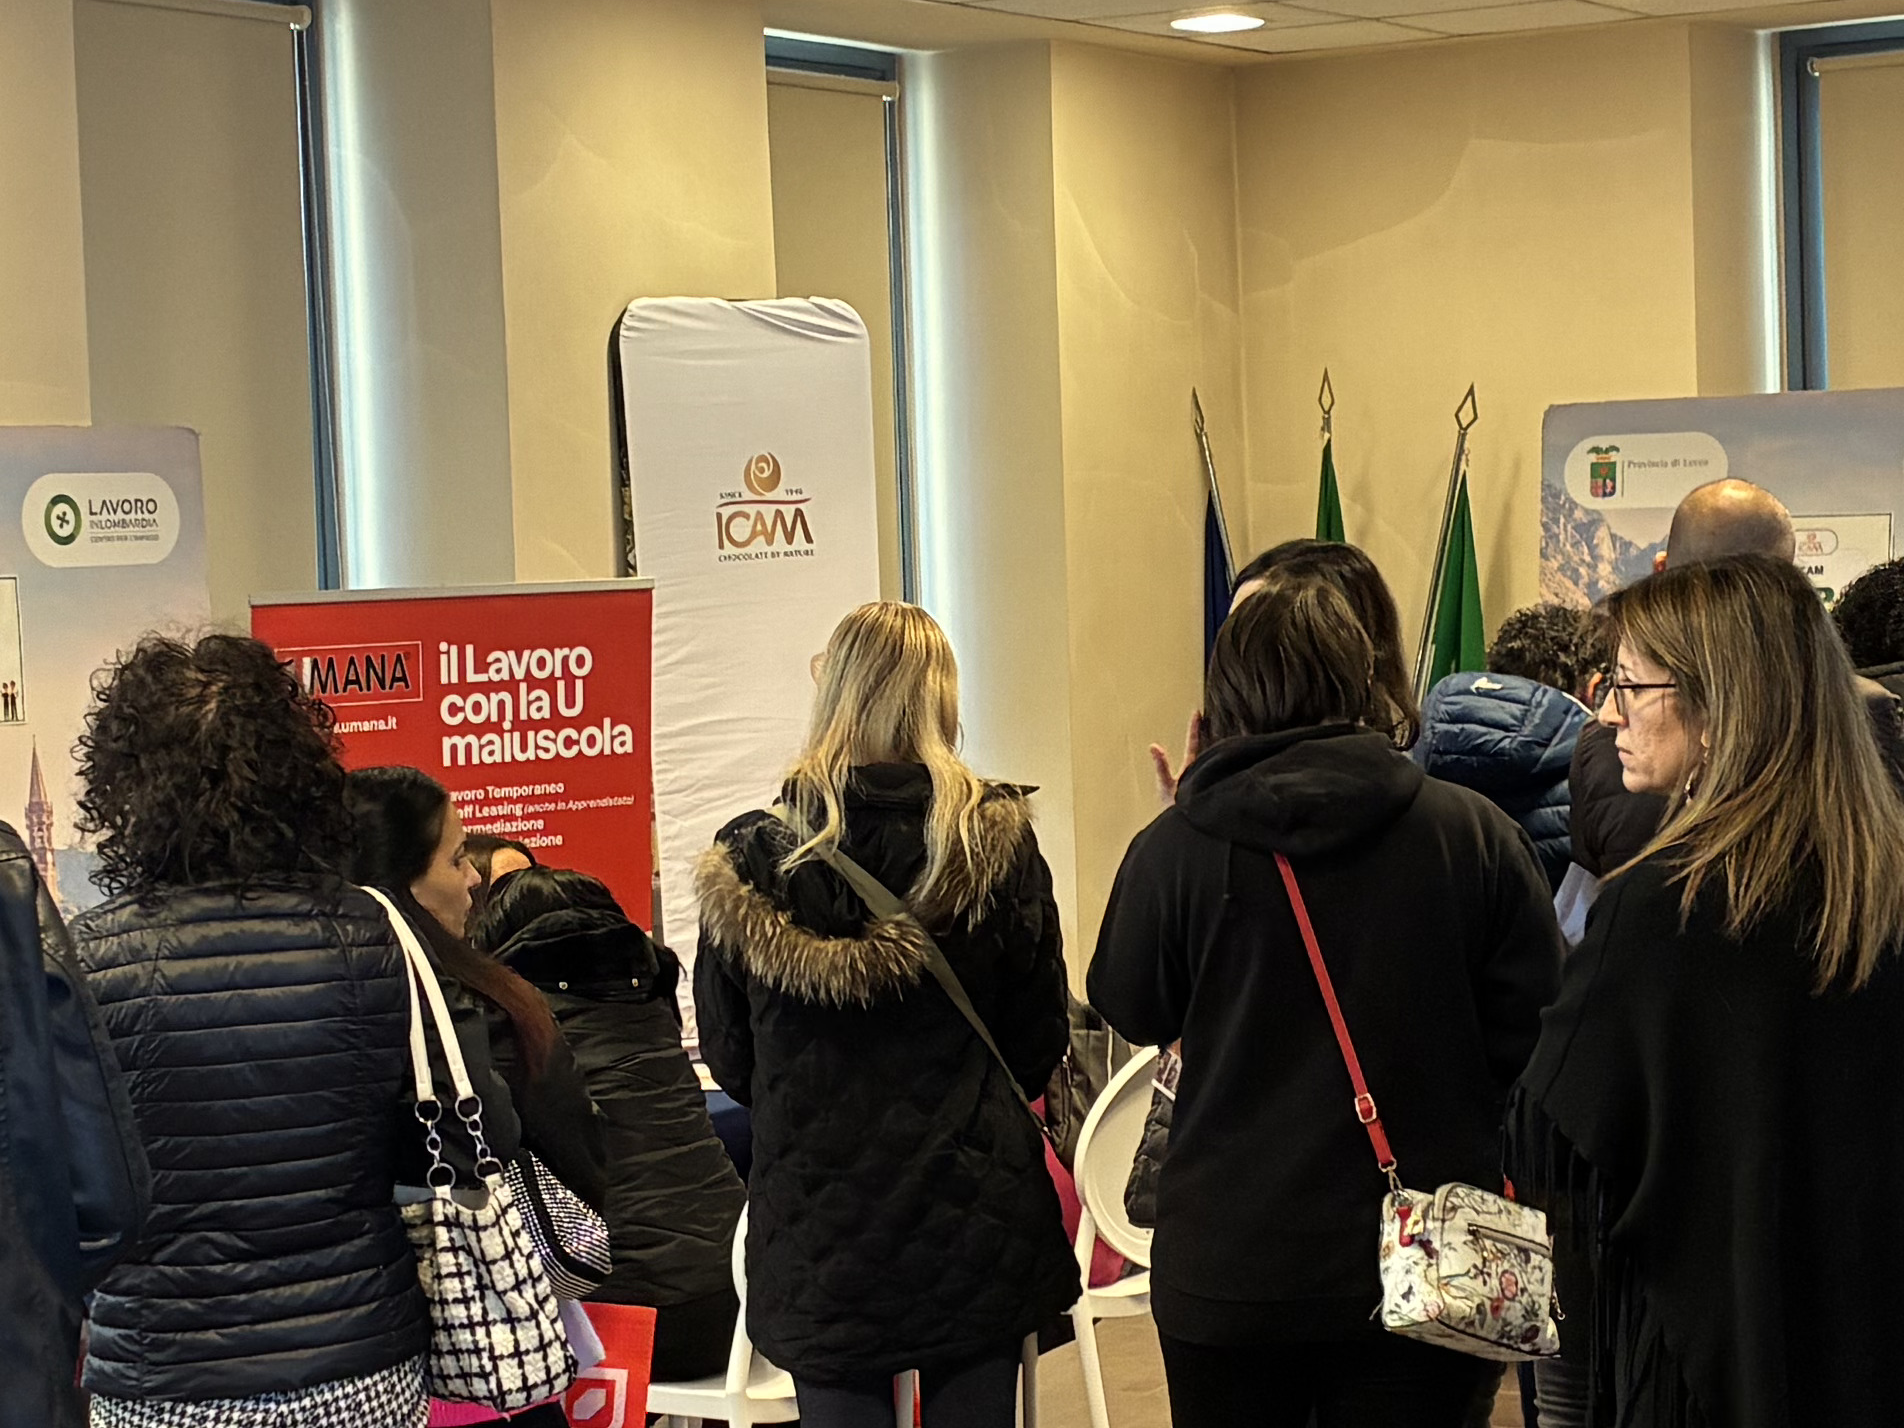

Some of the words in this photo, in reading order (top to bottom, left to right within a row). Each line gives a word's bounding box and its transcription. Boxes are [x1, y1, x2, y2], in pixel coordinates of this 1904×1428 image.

[88, 498, 158, 516] LAVORO
[715, 507, 815, 550] ICAM
[439, 641, 458, 684] il
[465, 644, 593, 683] Lavoro
[440, 691, 514, 726] con
[519, 682, 551, 720] la
[556, 678, 584, 718] U
[441, 717, 634, 767] maiuscola
[450, 790, 485, 803] avoro
[486, 782, 565, 801] Temporaneo
[475, 802, 524, 819] Leasing
